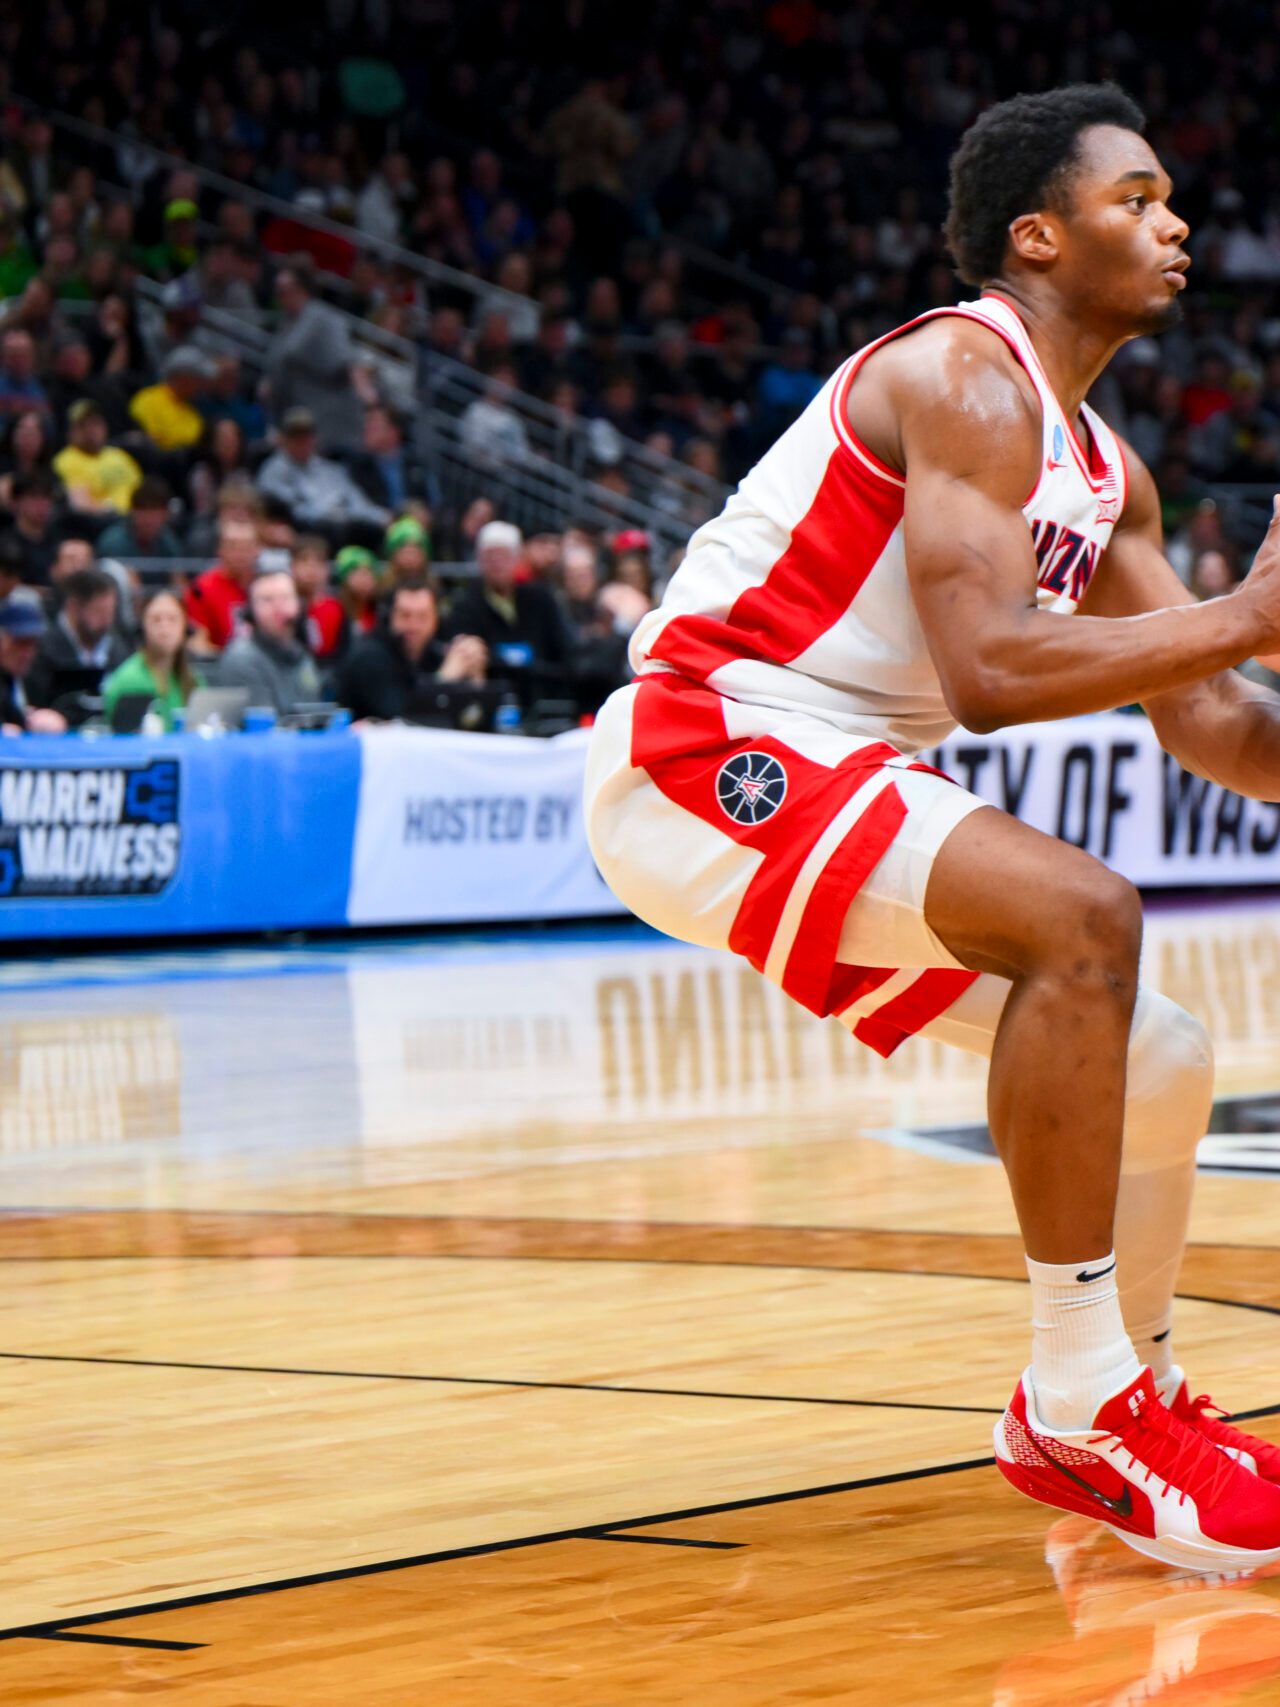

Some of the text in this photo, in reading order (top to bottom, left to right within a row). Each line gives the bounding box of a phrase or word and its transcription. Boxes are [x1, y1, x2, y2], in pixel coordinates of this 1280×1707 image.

[0, 769, 125, 825] MARCH
[403, 796, 576, 844] HOSTED BY
[1056, 741, 1139, 858] OF
[19, 823, 179, 882] MADNESS
